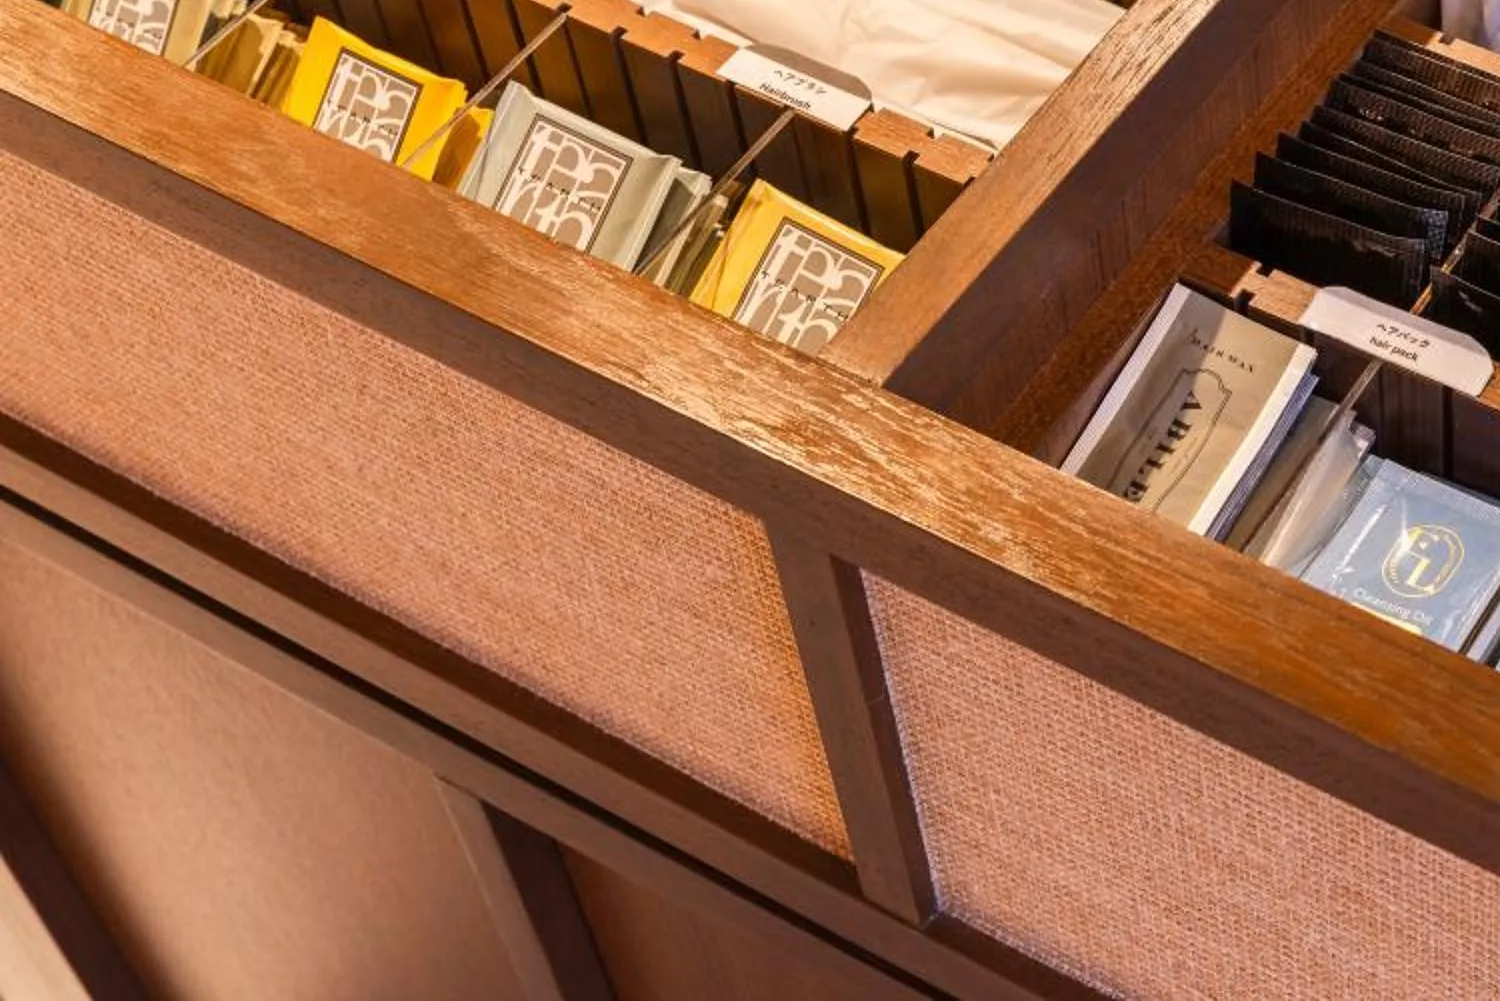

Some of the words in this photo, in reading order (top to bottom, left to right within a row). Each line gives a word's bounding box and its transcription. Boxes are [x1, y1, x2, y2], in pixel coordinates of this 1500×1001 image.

[1375, 324, 1430, 348] ヘアパック
[1369, 336, 1393, 350] hair
[1390, 345, 1419, 362] pack
